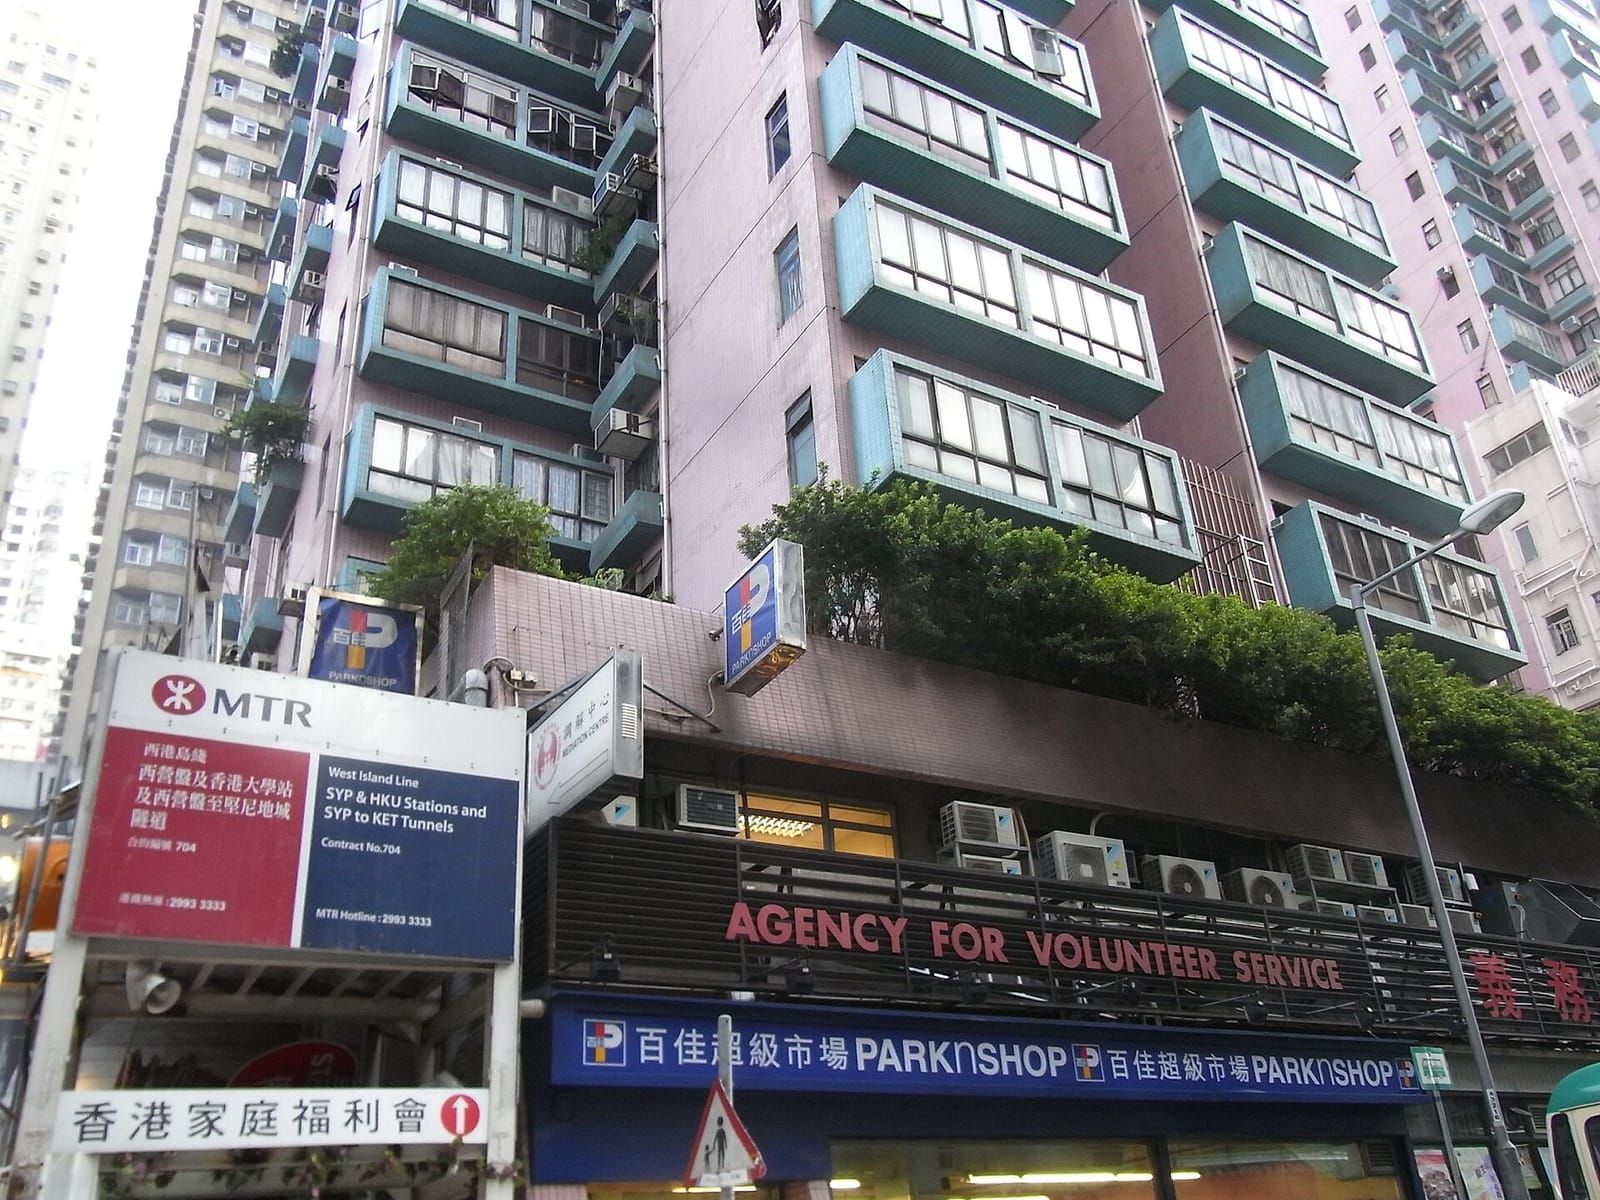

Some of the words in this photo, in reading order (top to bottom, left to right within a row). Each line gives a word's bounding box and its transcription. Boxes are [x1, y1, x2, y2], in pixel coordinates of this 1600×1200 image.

[213, 688, 312, 729] MTR
[562, 732, 588, 758] MEDIATION
[588, 713, 609, 736] CENTRE
[138, 763, 293, 799] 西營盤及香港大學站
[329, 766, 356, 780] West
[359, 771, 393, 785] Island
[396, 776, 420, 788] Line
[135, 786, 291, 821] 及西營盤至堅尼地城
[326, 787, 353, 802] SYP
[356, 791, 367, 804] &
[370, 793, 401, 808] HKU
[404, 797, 458, 815] Stations
[461, 805, 487, 819] and
[130, 808, 168, 831] 隧道
[324, 806, 351, 821] SYP
[355, 811, 369, 824] to
[373, 812, 399, 828] KET
[401, 815, 454, 833] Tunnels
[175, 841, 197, 852] 704
[321, 837, 364, 851] Contract
[199, 899, 226, 911] 3333
[316, 908, 338, 919] MTR
[340, 910, 376, 922] Hotline
[408, 916, 432, 927] 3333
[725, 902, 907, 955] AGENCY
[931, 921, 1008, 964] FOR
[1026, 930, 1221, 981] VOLUNTEER
[1233, 950, 1344, 991] SERVICE
[636, 1027, 848, 1071] 百佳超級市場
[1107, 1050, 1249, 1082] 百佳超級市場
[73, 1096, 428, 1144] 香港家庭福利會
